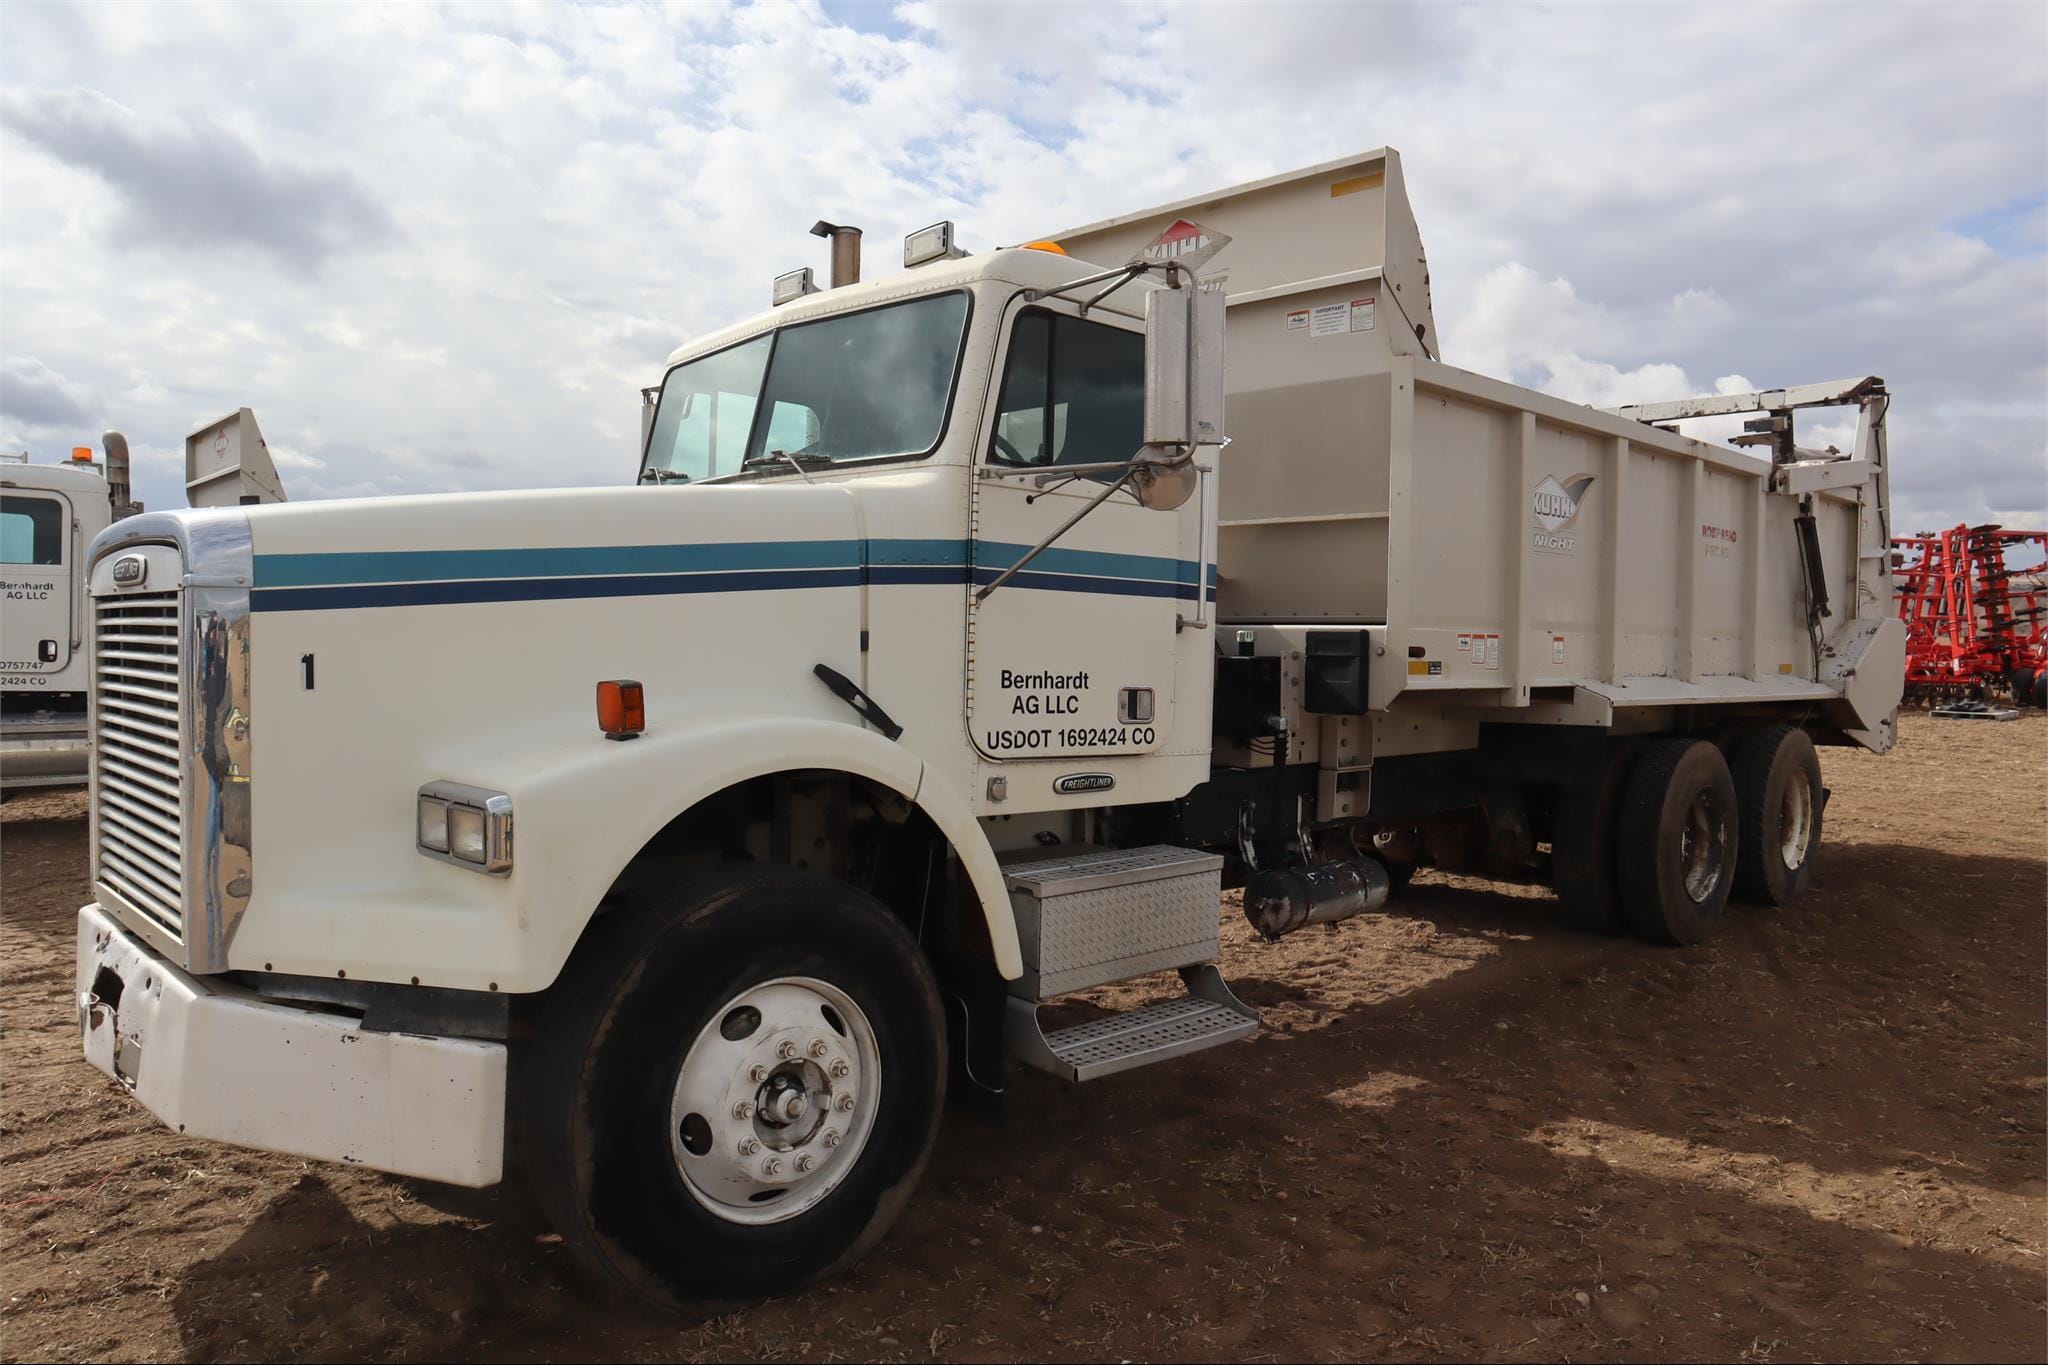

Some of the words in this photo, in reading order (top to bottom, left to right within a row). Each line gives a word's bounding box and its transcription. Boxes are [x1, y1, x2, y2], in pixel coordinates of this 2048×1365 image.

[0, 581, 54, 591] Bernhardt
[7, 591, 23, 600] AG
[26, 591, 48, 600] LLC
[301, 653, 315, 690] 1
[30, 677, 47, 685] CO
[1001, 669, 1089, 690] Bernhardt
[1012, 695, 1040, 714] AG
[1045, 695, 1079, 714] LLC
[987, 729, 1052, 750] USDOT
[1058, 727, 1127, 747] 1692424
[1132, 727, 1155, 745] CO
[1063, 777, 1112, 789] FREIGHTLINER
